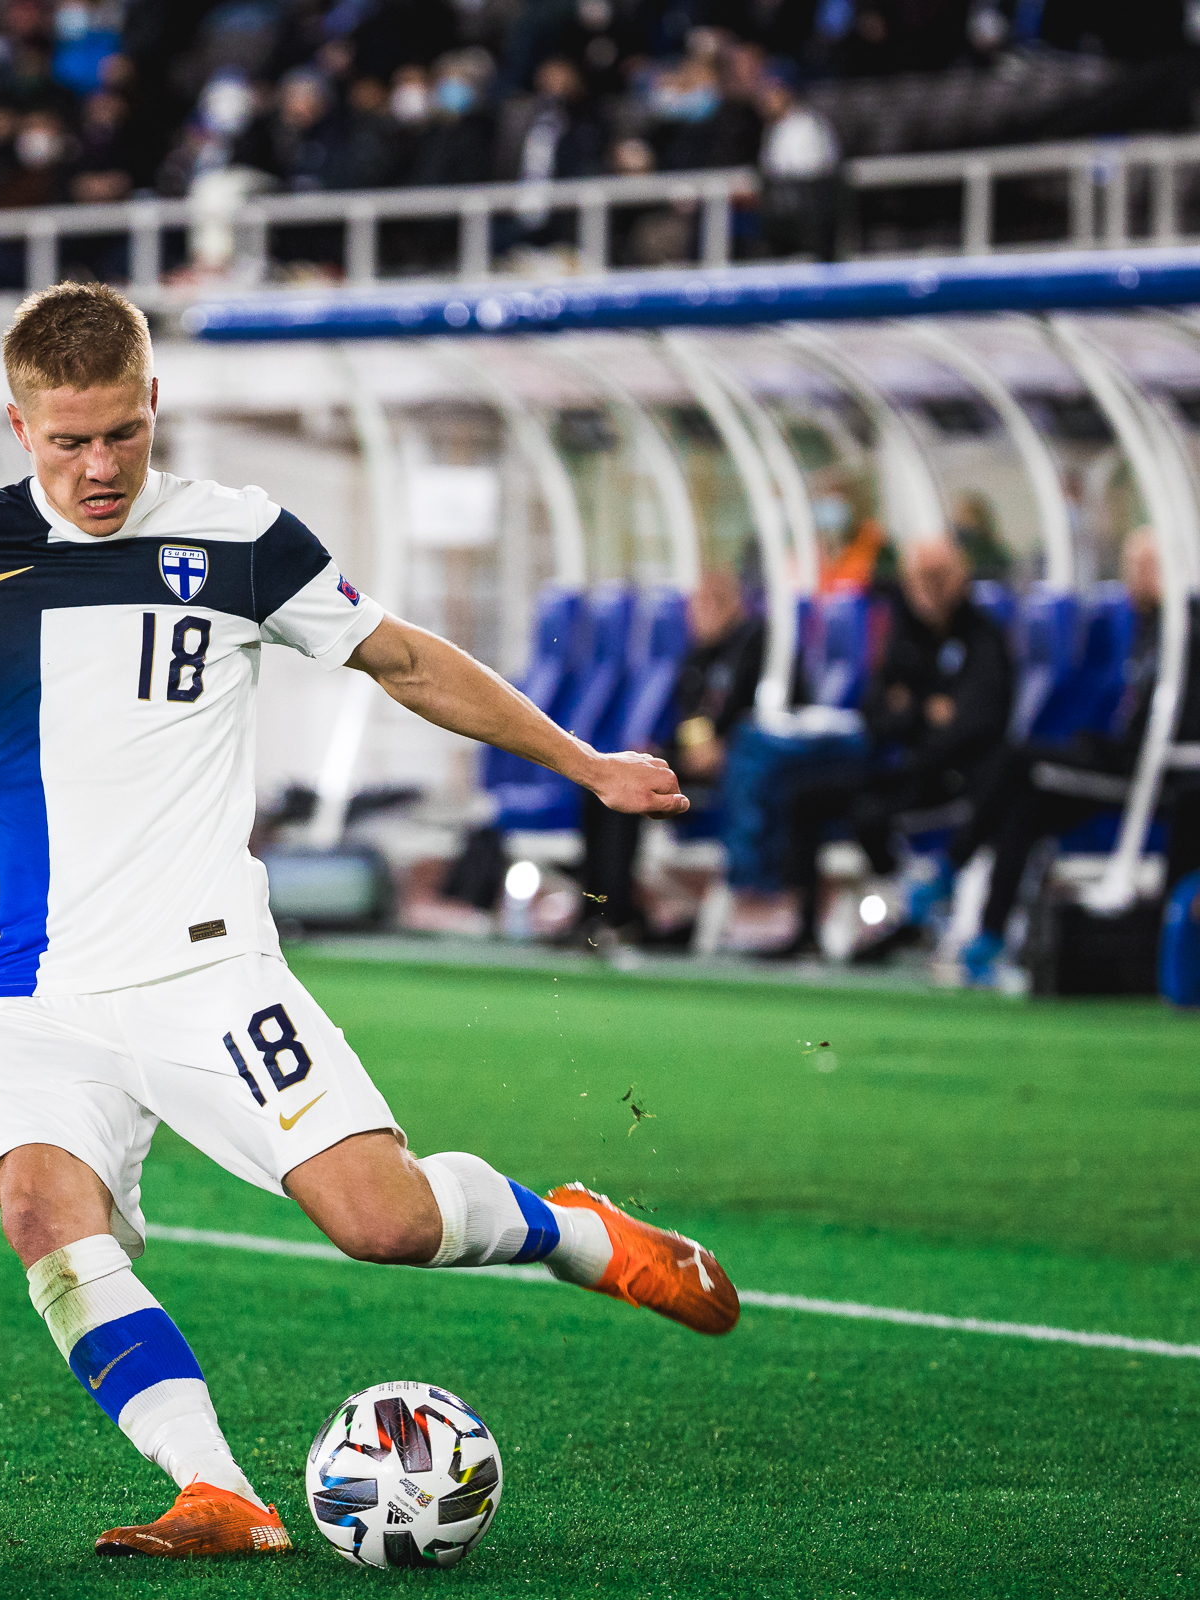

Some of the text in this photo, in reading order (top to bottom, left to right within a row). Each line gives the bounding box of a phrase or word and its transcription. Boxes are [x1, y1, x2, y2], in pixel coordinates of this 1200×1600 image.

[138, 612, 212, 703] 18
[223, 1003, 313, 1107] 18
[387, 1501, 414, 1522] adidas
